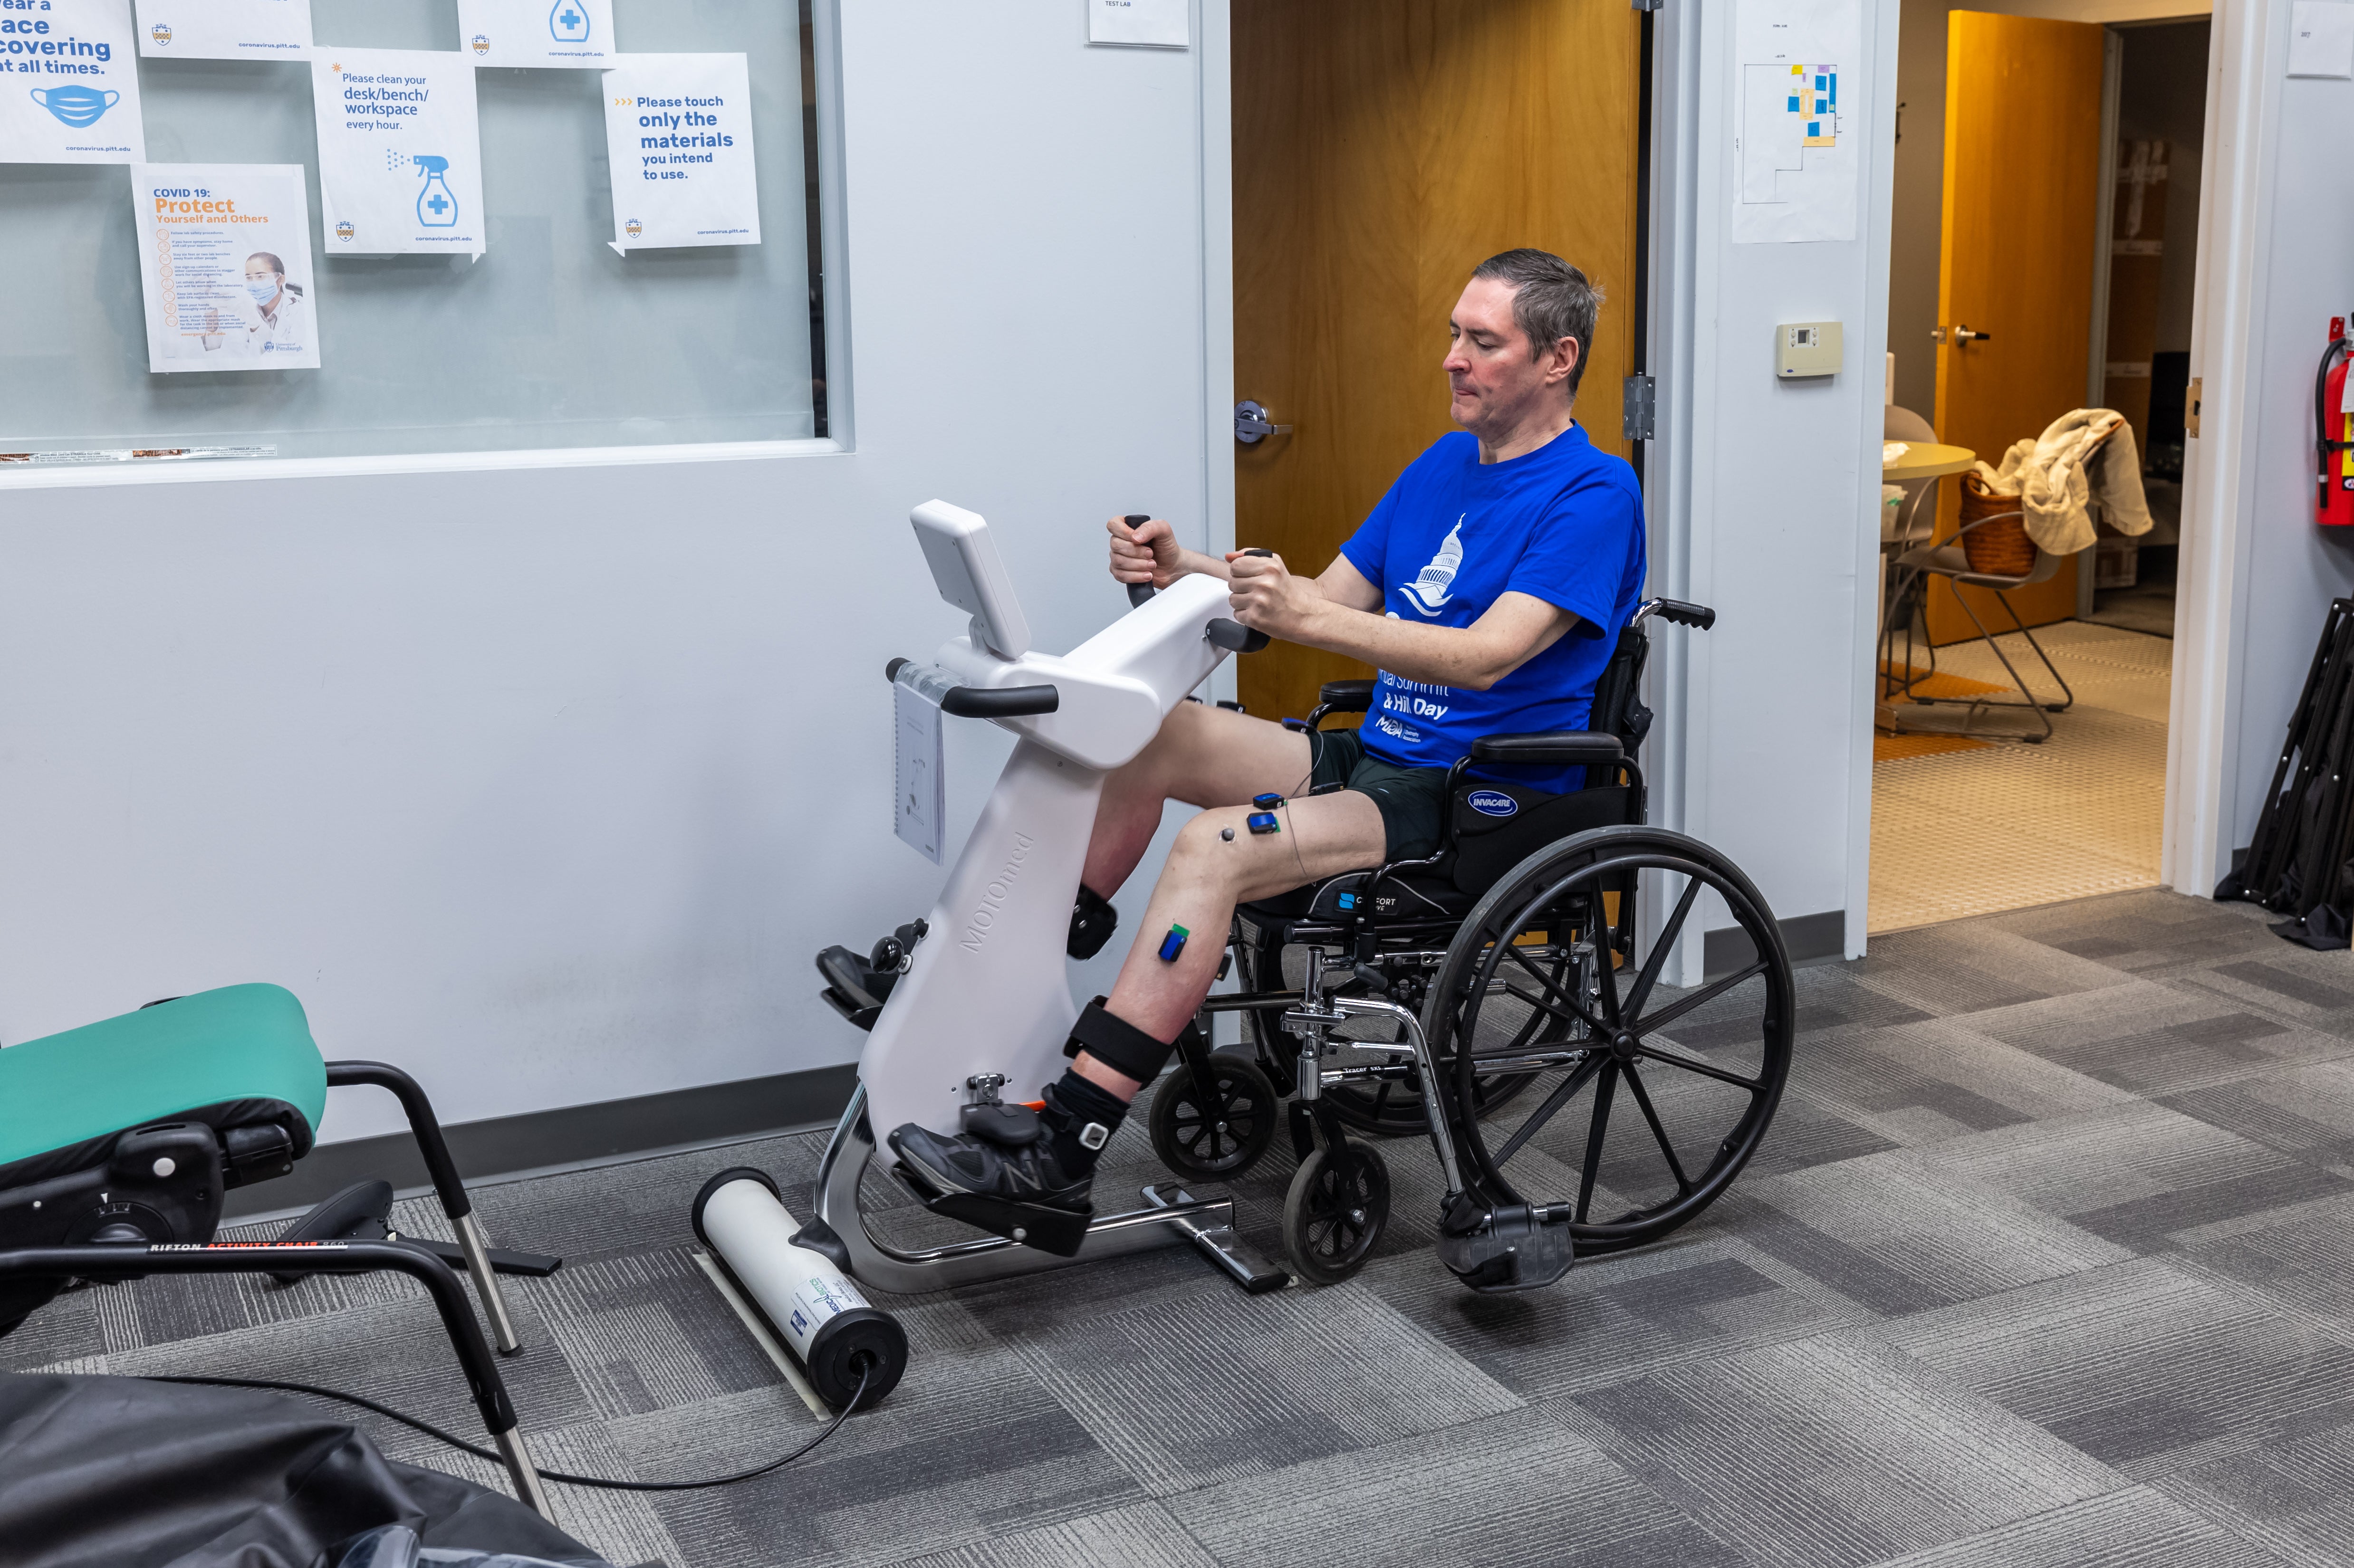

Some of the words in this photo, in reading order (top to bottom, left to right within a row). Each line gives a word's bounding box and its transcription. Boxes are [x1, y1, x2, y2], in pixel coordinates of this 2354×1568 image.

[0, 0, 35, 10] ear
[40, 1, 51, 10] a
[1, 19, 49, 34] ace
[19, 60, 40, 73] all
[45, 60, 105, 74] times.
[343, 73, 374, 84] Please
[376, 74, 402, 85] clean
[404, 76, 426, 86] your
[344, 87, 429, 102] desk/bench/
[637, 97, 682, 107] Please
[685, 96, 723, 106] touch
[345, 103, 418, 117] workspace
[346, 121, 374, 131] every
[376, 120, 403, 130] hour.
[639, 112, 681, 130] only
[684, 112, 717, 126] the
[641, 133, 733, 148] materials
[642, 155, 666, 166] you
[670, 153, 713, 163] intend
[643, 170, 657, 180] to
[661, 170, 688, 179] use.
[154, 189, 191, 197] COVID
[194, 189, 211, 197] 19:
[155, 198, 235, 213] Protect
[156, 215, 203, 223] Yourself
[1384, 692, 1393, 709] &
[1393, 694, 1412, 714] Hill
[1413, 698, 1449, 720] Day
[1473, 799, 1510, 807] INVACARE
[959, 832, 1035, 954] MOTOmed
[1356, 897, 1396, 906] CFORT
